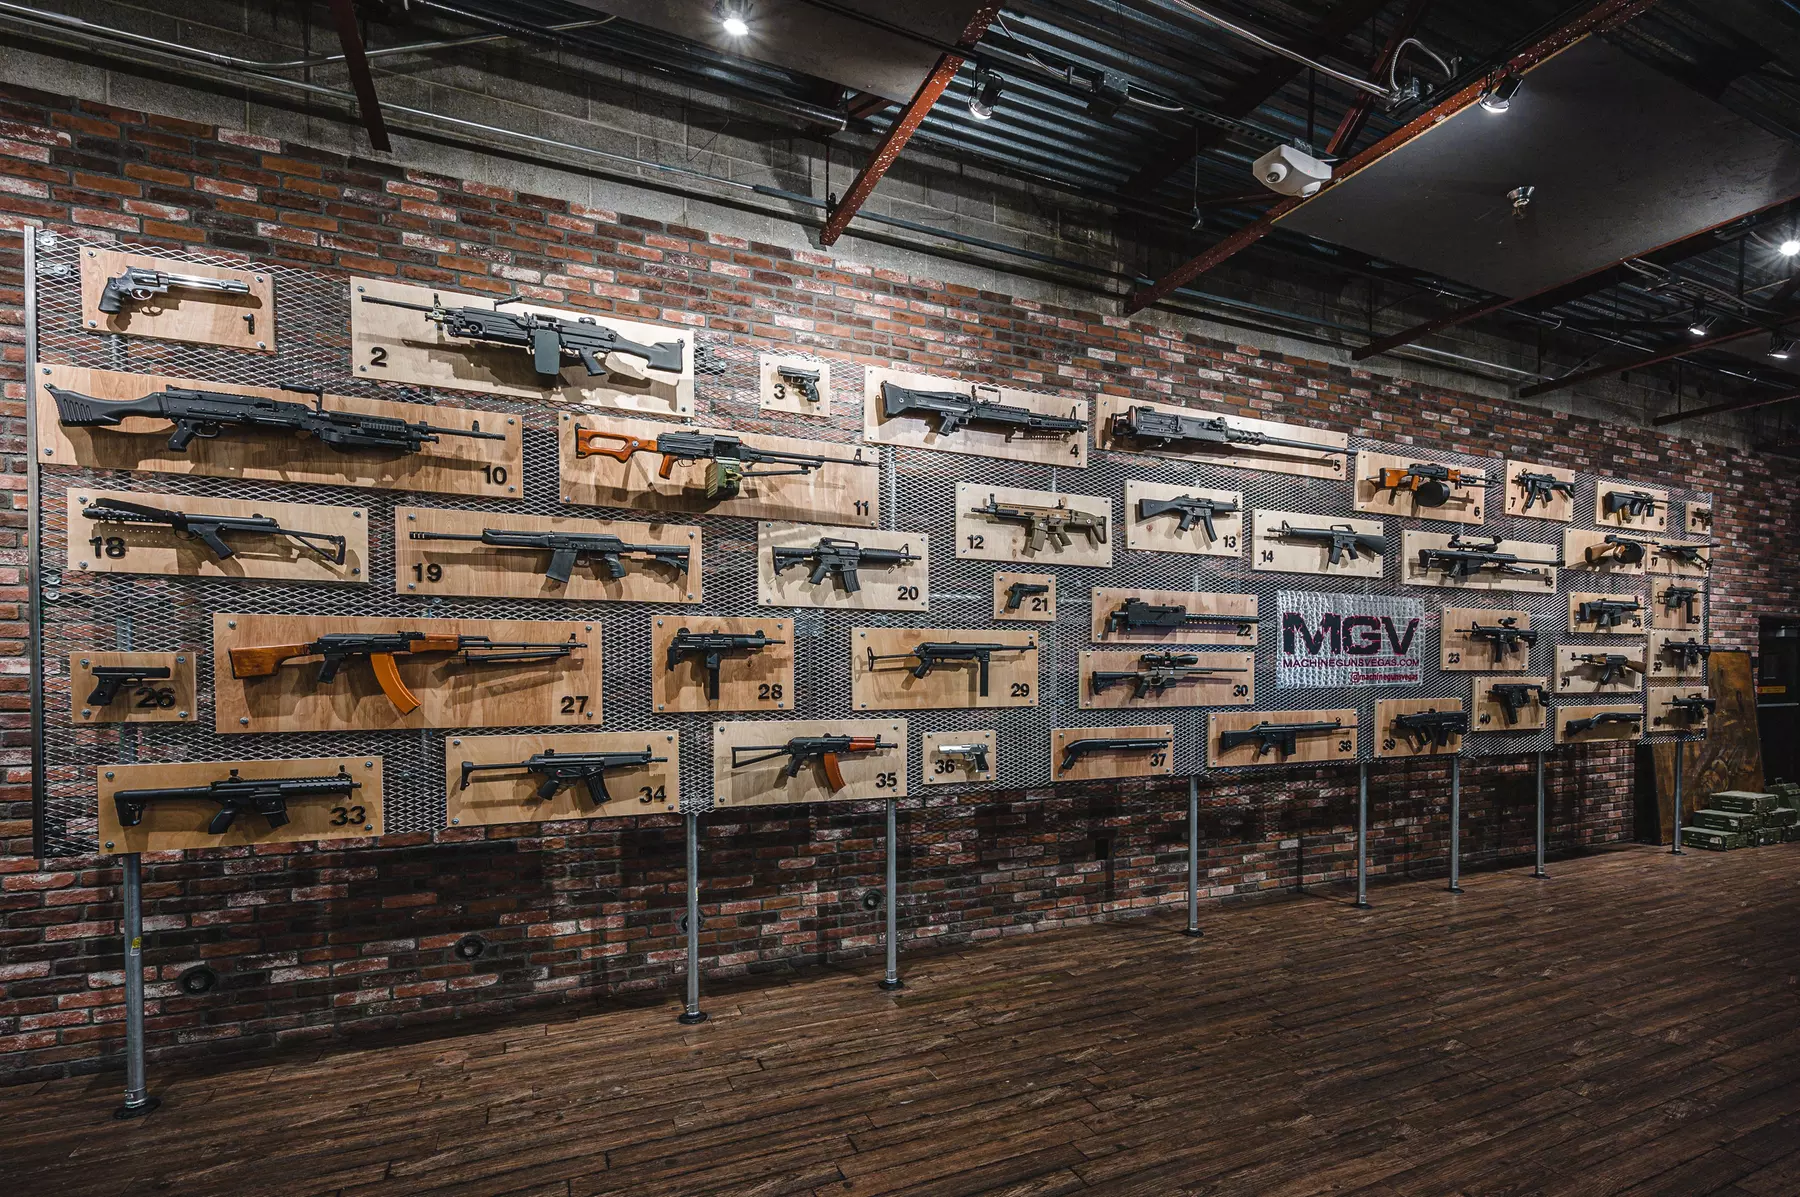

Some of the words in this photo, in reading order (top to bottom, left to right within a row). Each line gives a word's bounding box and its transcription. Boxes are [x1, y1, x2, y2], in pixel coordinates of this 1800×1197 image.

[243, 313, 255, 335] 1
[370, 346, 387, 367] 2
[775, 383, 785, 399] 3
[1070, 444, 1079, 457] 4
[1333, 459, 1341, 472] 5
[480, 465, 506, 486] 10
[852, 499, 869, 516] 11
[1511, 497, 1517, 508] 7
[1474, 506, 1480, 517] 6
[89, 535, 126, 560] 18
[967, 535, 985, 550] 12
[1223, 535, 1237, 549] 13
[1261, 550, 1275, 562] 14
[412, 562, 443, 583] 19
[1544, 576, 1553, 586] 15
[897, 585, 919, 601] 20
[1031, 597, 1048, 612] 21
[1236, 624, 1252, 637] 22
[1282, 612, 1420, 656] MGV
[1282, 658, 1419, 668] MACHINEGUNSVEGAS.COM
[1448, 652, 1459, 663] 23
[134, 686, 176, 709] 26
[757, 683, 782, 700] 28
[1010, 682, 1031, 698] 29
[1232, 684, 1249, 698] 30
[560, 695, 589, 714] 27
[934, 758, 956, 775] 36
[1151, 752, 1168, 768] 37
[876, 772, 896, 788] 35
[639, 785, 667, 804] 34
[329, 806, 366, 826] 33
